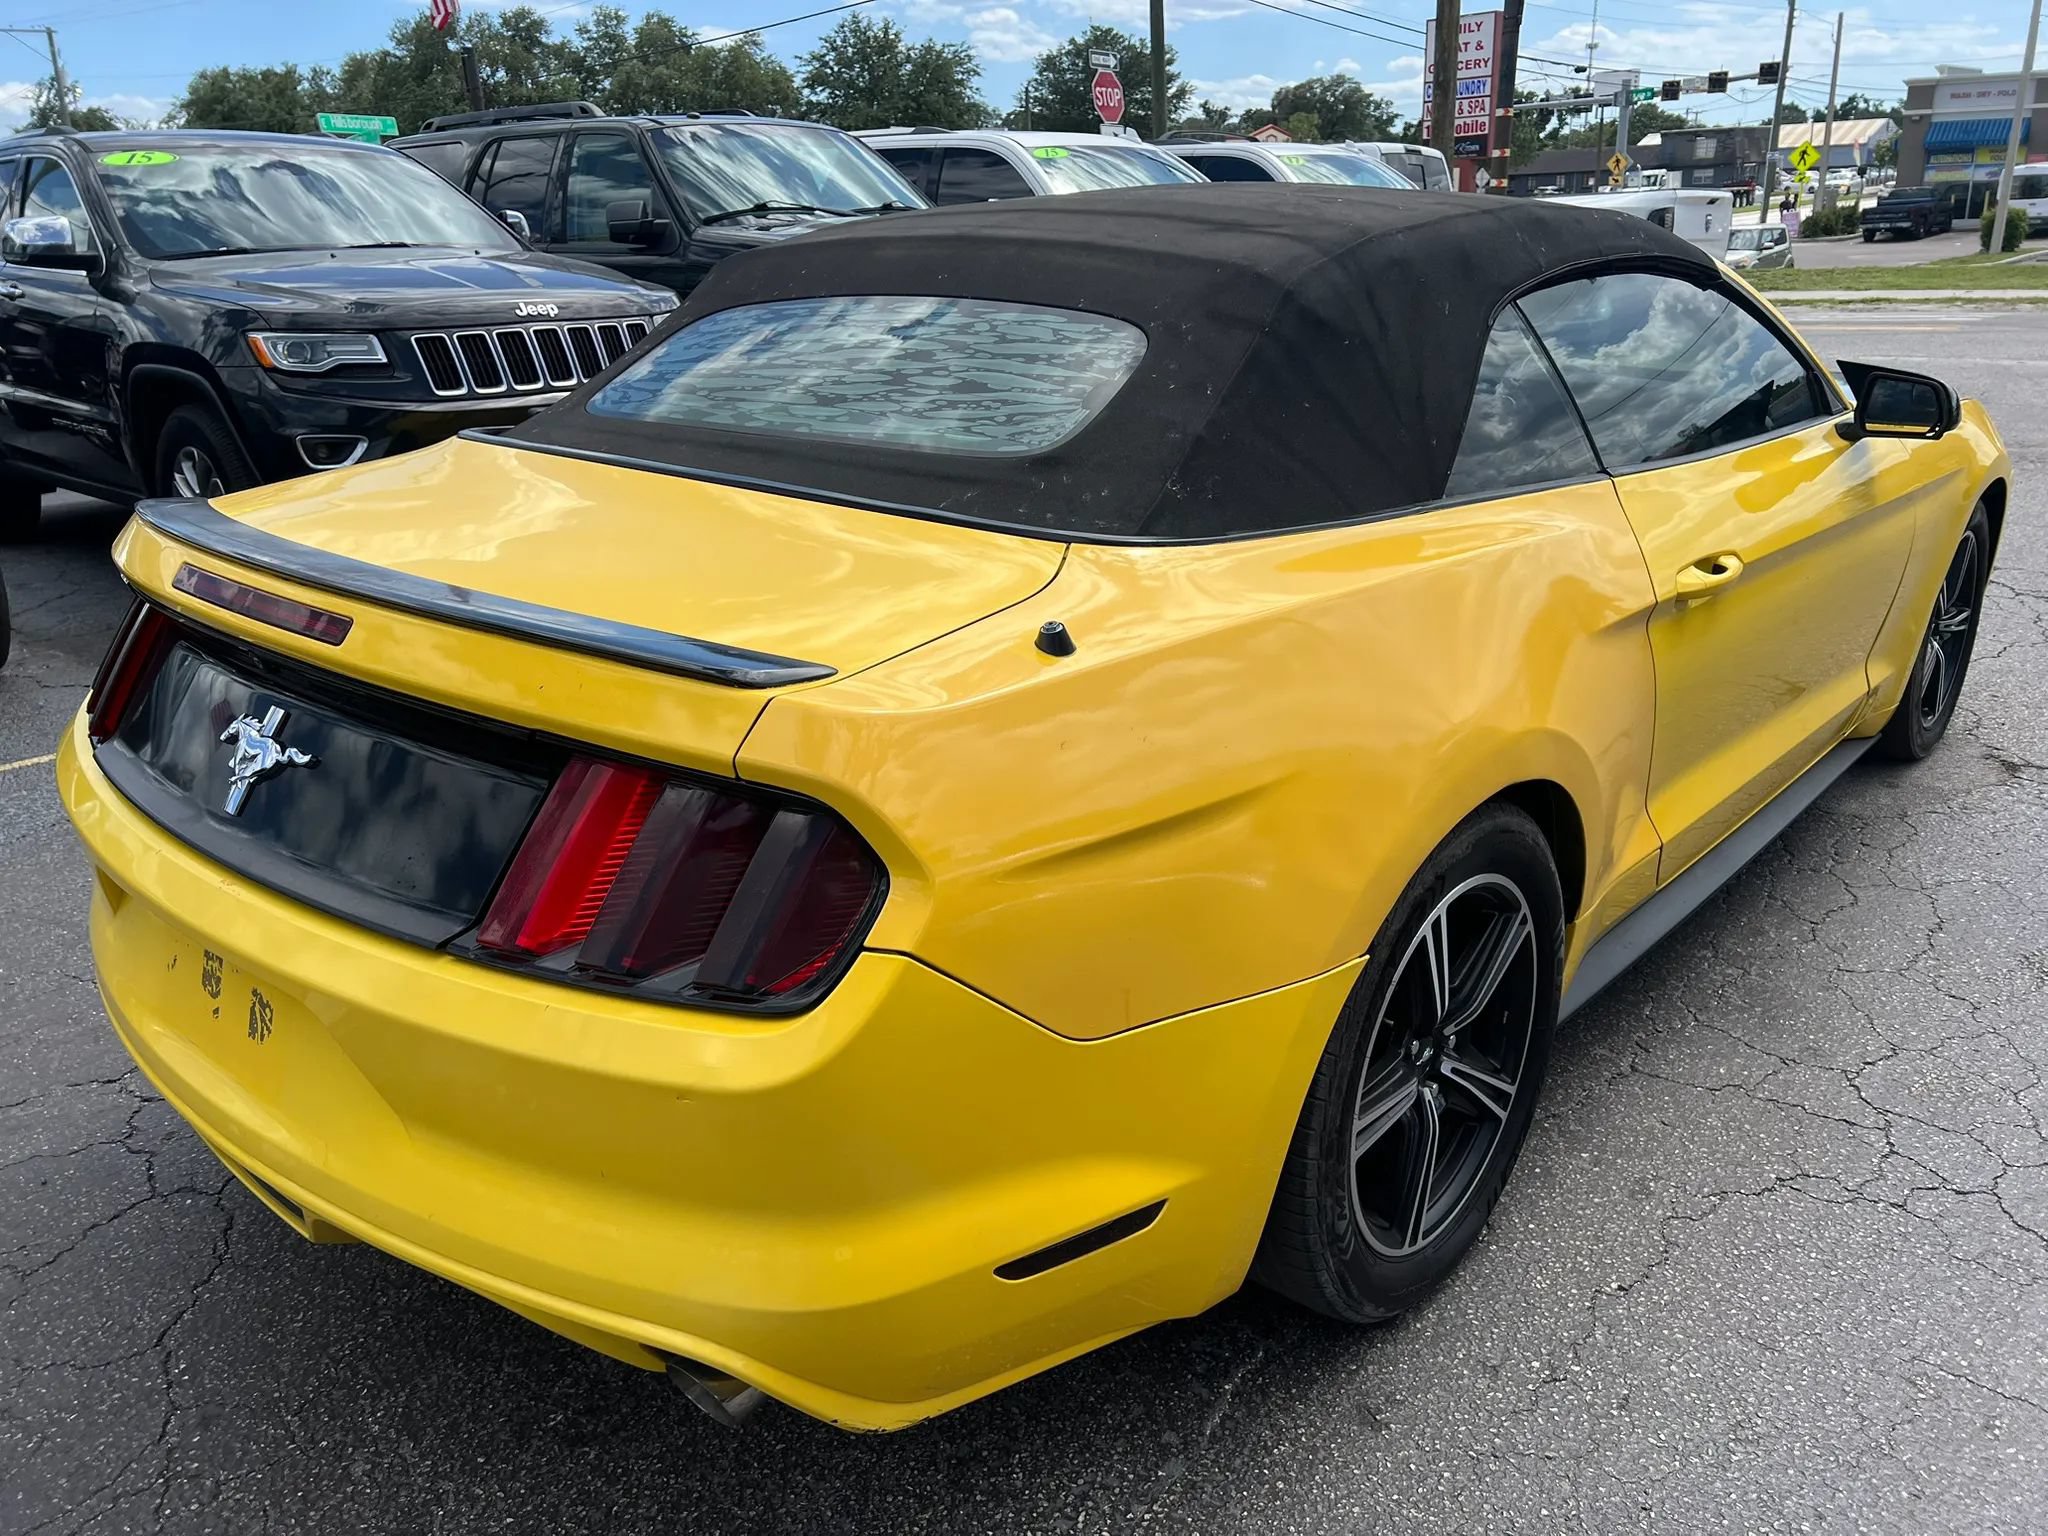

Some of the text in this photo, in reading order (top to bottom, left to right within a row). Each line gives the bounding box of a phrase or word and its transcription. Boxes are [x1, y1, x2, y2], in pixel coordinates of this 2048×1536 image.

[1475, 40, 1484, 51] &
[1428, 57, 1491, 73] GCERY
[1456, 79, 1488, 96] UNDRY
[1095, 86, 1120, 107] STOP
[1457, 99, 1486, 115] & SPA
[1455, 119, 1486, 135] obile
[125, 152, 155, 164] 15
[1044, 148, 1058, 157] 15
[515, 302, 559, 318] Jeep
